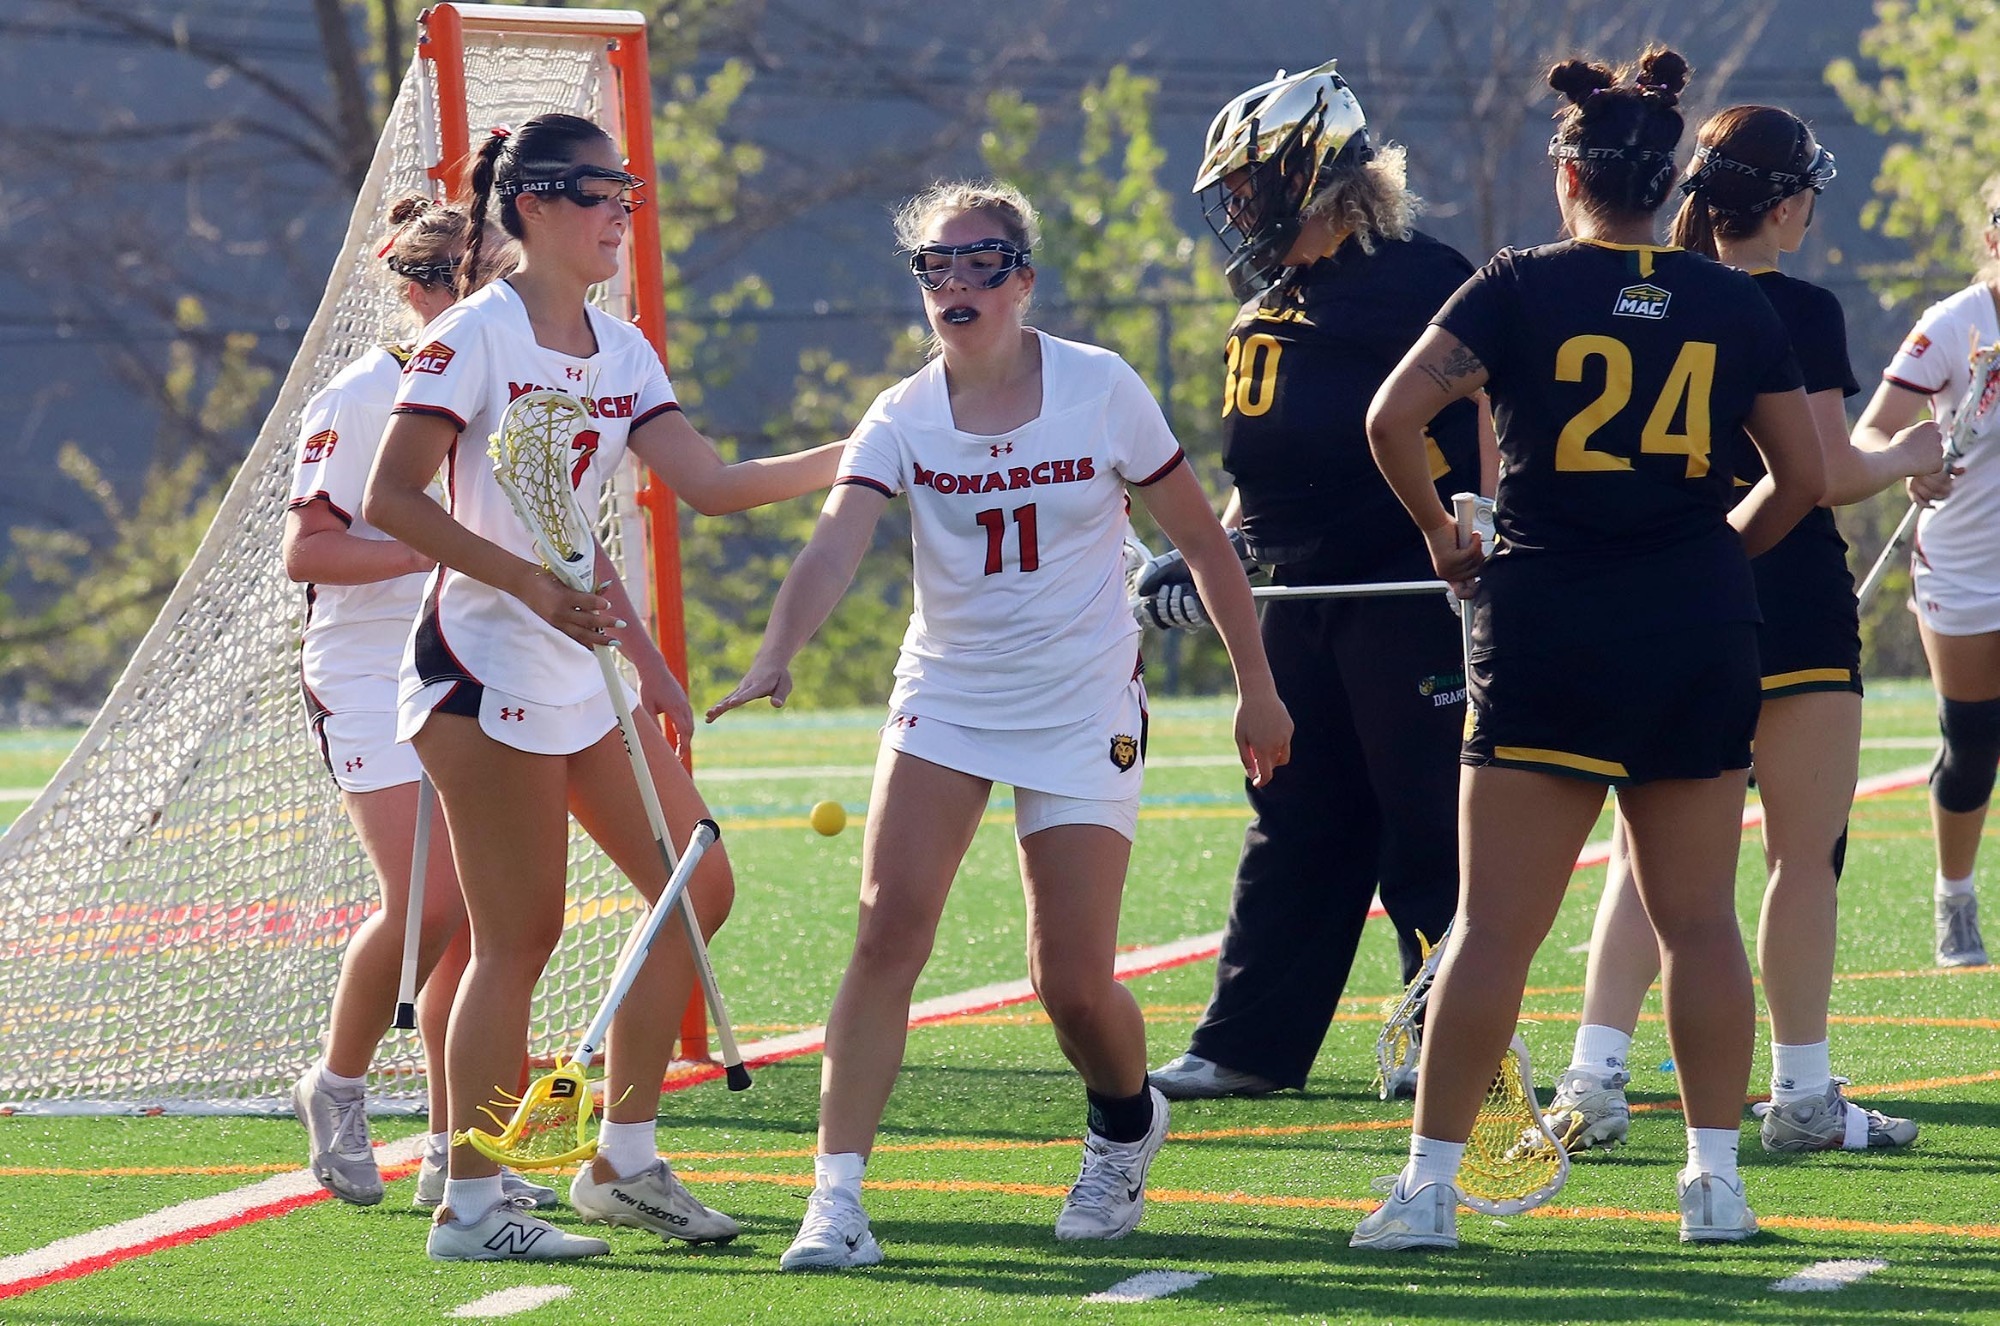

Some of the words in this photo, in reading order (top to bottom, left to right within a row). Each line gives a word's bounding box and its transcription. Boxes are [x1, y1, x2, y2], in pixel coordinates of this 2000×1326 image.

[1587, 148, 1625, 159] STX
[522, 182, 550, 192] GAIT
[1769, 171, 1801, 184] STX
[1618, 298, 1665, 316] MAC
[1554, 333, 1718, 479] 24
[913, 456, 1096, 495] MONARCHS
[975, 502, 1040, 577] 11
[611, 1188, 637, 1207] new
[636, 1200, 689, 1227] balance
[483, 1221, 548, 1255] N
